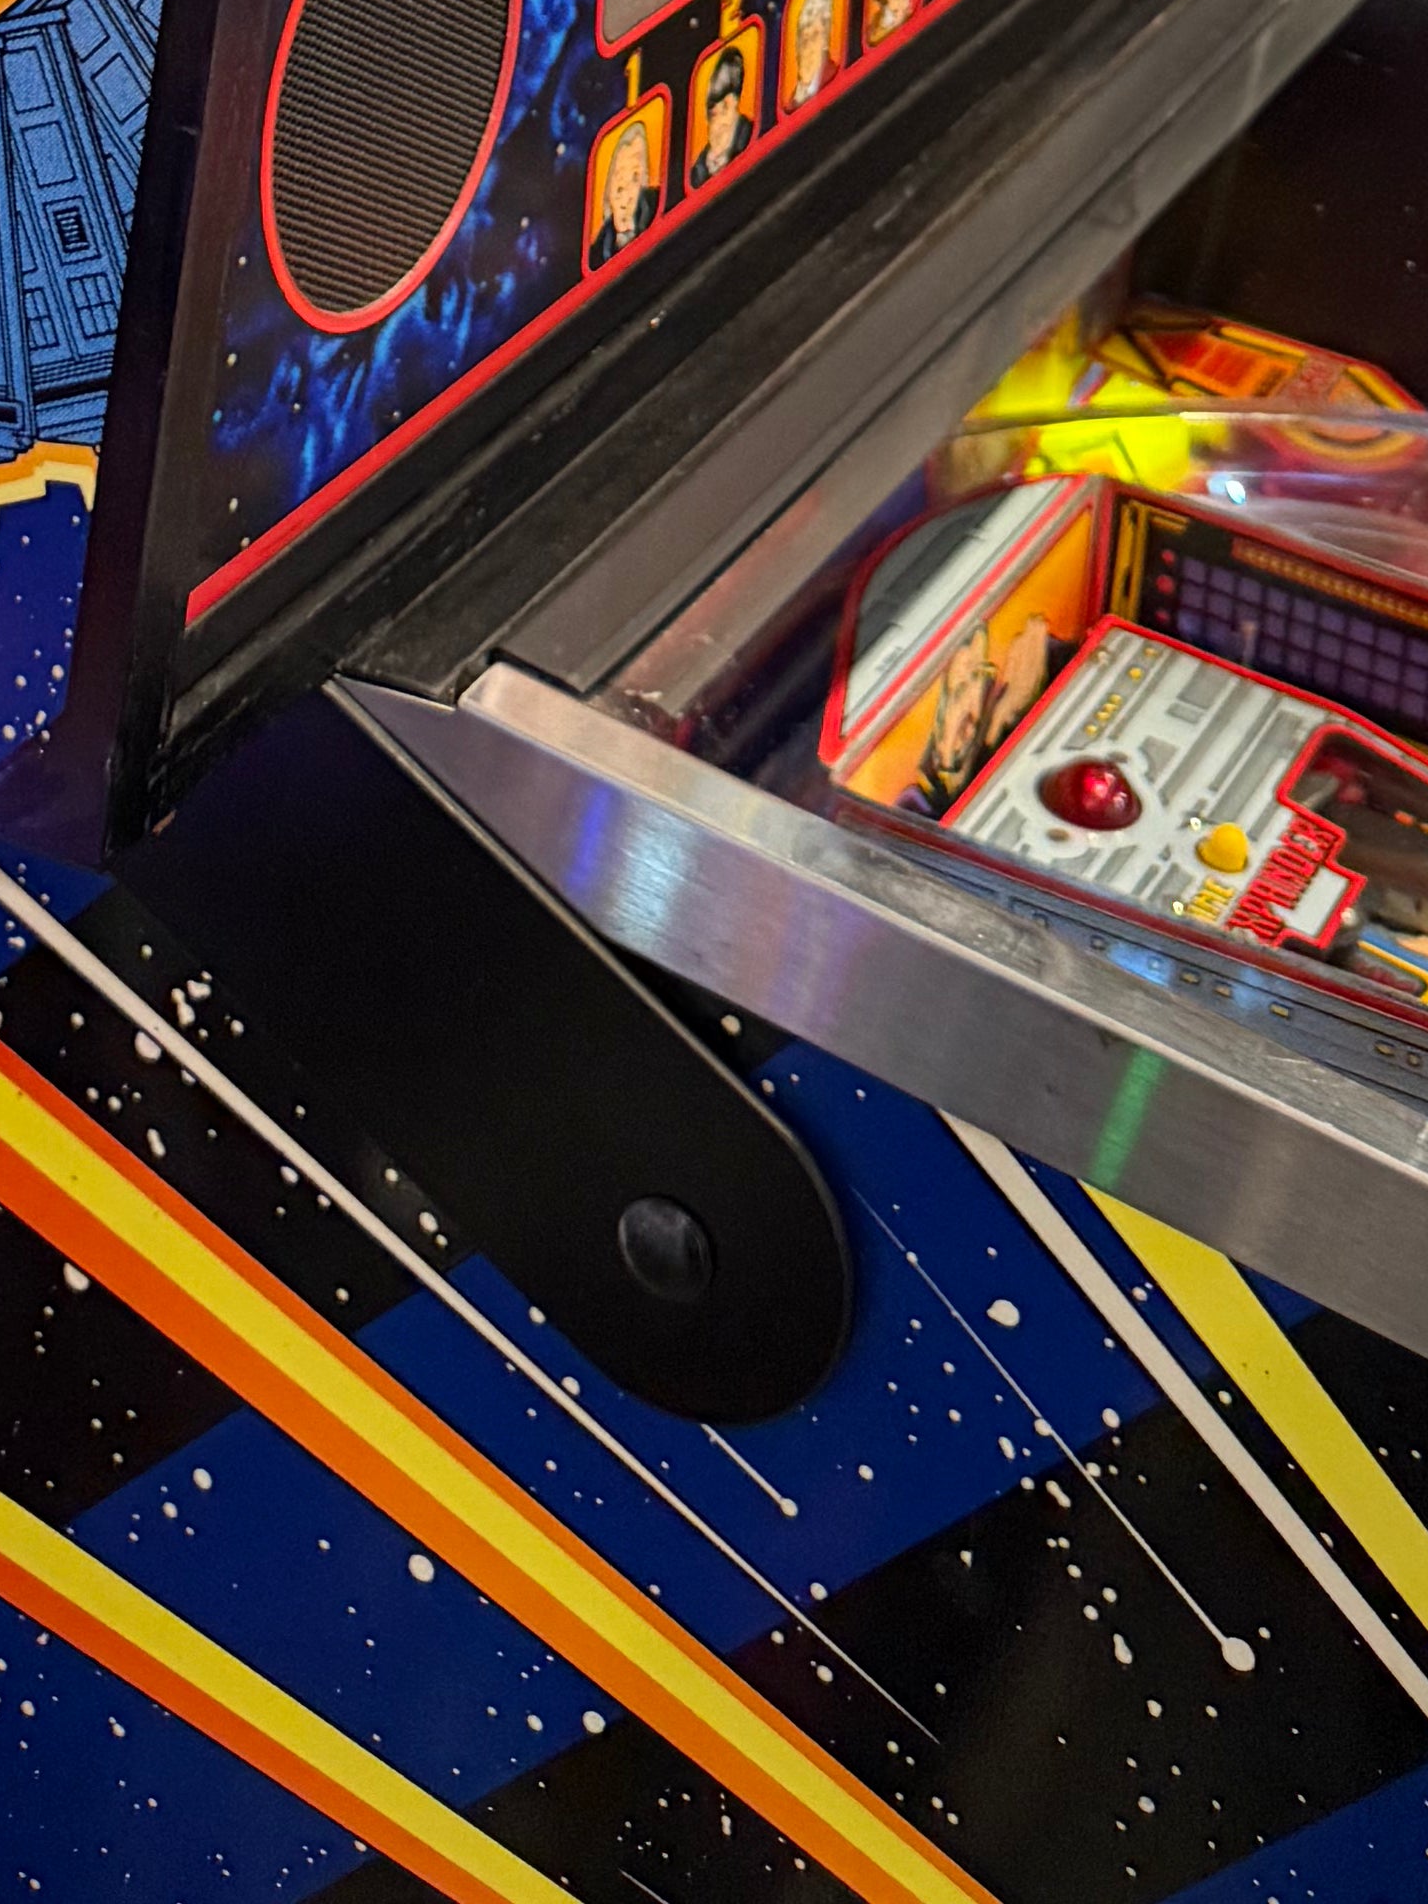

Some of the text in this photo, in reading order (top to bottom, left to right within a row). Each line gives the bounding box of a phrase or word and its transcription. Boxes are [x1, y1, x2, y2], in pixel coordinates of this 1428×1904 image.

[624, 47, 642, 108] 1
[1185, 876, 1236, 925] IME
[1224, 814, 1343, 949] XPANDER
